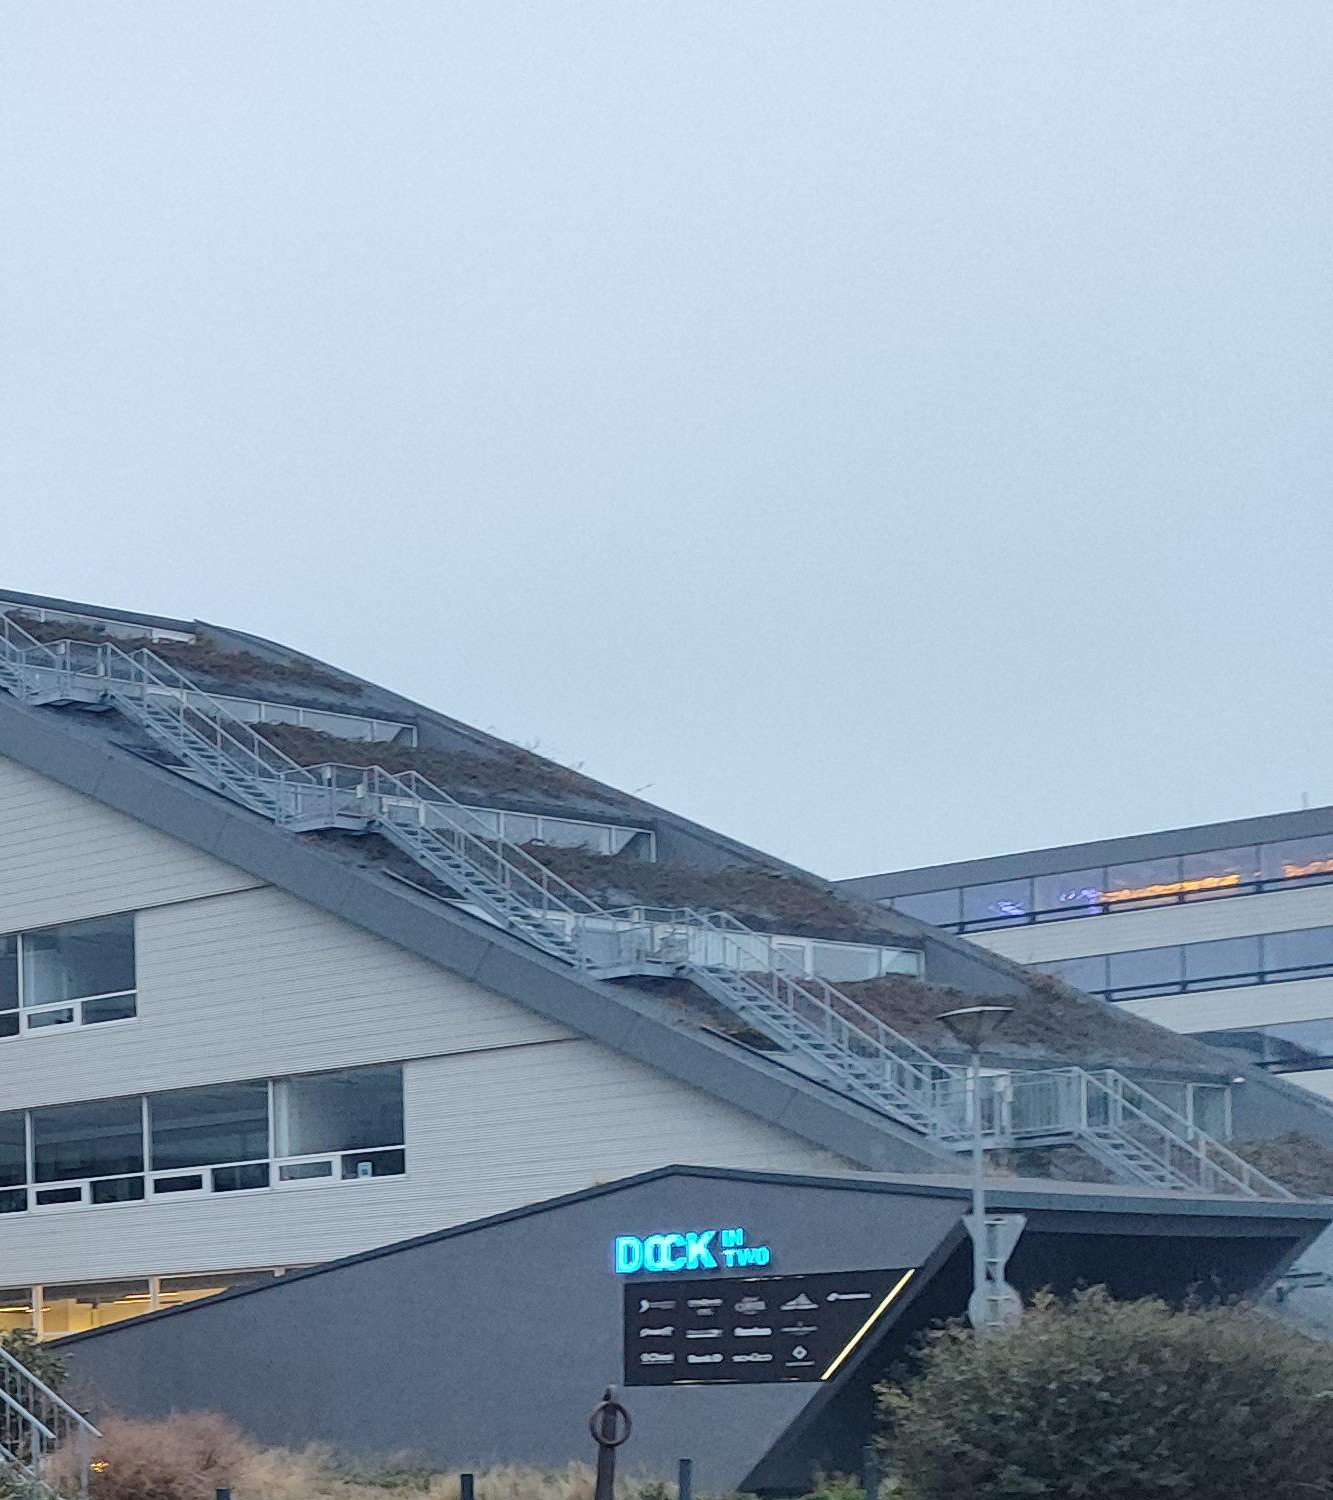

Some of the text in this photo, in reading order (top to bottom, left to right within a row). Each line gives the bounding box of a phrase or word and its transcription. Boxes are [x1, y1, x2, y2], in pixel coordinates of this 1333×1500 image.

[615, 1227, 744, 1274] DOCK IN
[721, 1246, 770, 1268] TWO
